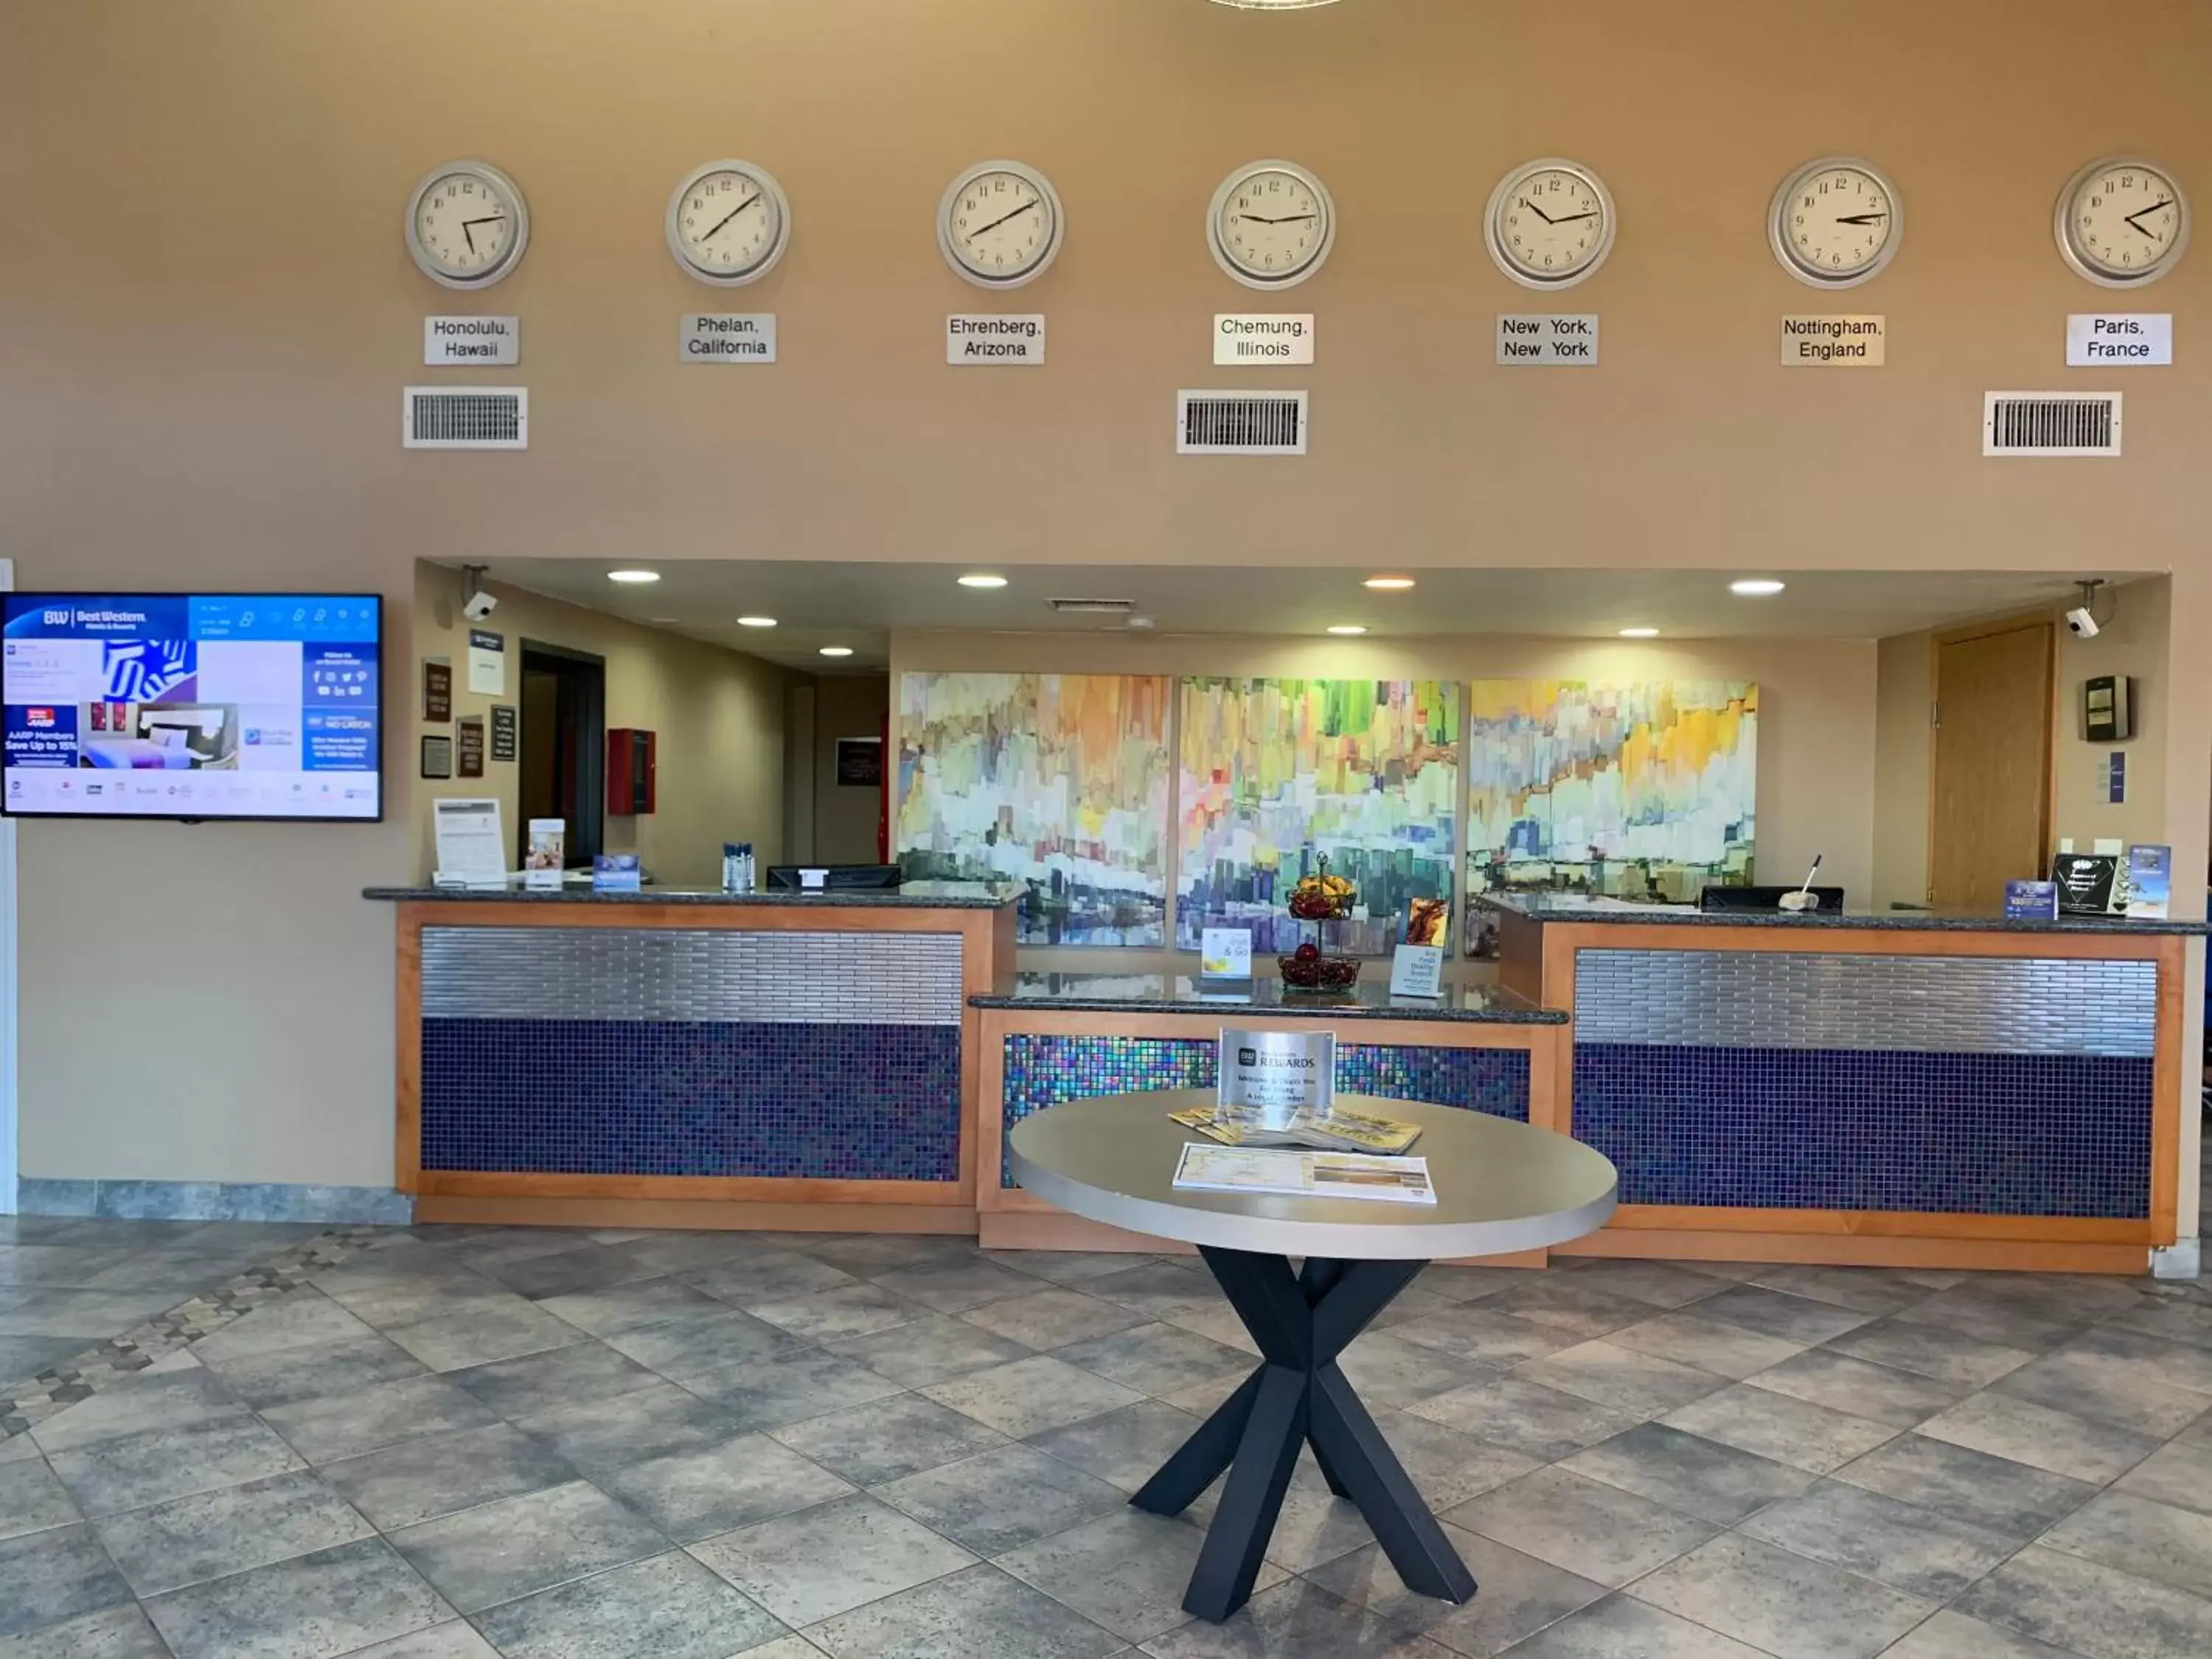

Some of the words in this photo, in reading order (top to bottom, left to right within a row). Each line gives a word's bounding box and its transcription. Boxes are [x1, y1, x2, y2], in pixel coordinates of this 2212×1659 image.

[721, 181, 731, 191] 12
[995, 181, 1004, 192] 12
[1269, 181, 1279, 192] 12
[1549, 180, 1560, 191] 12
[1836, 178, 1846, 189] 12
[2106, 181, 2114, 193] 11
[2122, 176, 2132, 187] 12
[2144, 179, 2147, 191] 1
[448, 186, 456, 197] 11
[463, 183, 473, 193] 12
[706, 184, 714, 196] 11
[742, 184, 745, 194] 1
[980, 186, 987, 197] 11
[1016, 184, 1019, 195] 1
[1253, 184, 1262, 195] 11
[1290, 186, 1293, 196] 1
[1534, 184, 1542, 195] 11
[1571, 184, 1574, 196] 1
[1819, 183, 1827, 194] 11
[1857, 183, 1861, 194] 1
[483, 189, 486, 199] 1
[434, 198, 444, 208] 10
[694, 199, 703, 209] 10
[967, 200, 975, 210] 10
[1239, 198, 1248, 209] 10
[1301, 200, 1308, 210] 2
[1519, 198, 1528, 208] 10
[1582, 200, 1589, 210] 2
[1805, 197, 1815, 207] 10
[1869, 197, 1877, 207] 2
[2093, 196, 2101, 207] 10
[427, 216, 433, 225] 9
[687, 217, 694, 227] 9
[960, 218, 967, 227] 9
[1231, 216, 1237, 225] 9
[1510, 216, 1517, 226] 9
[1796, 215, 1804, 226] 9
[2084, 216, 2091, 226] 9
[2163, 213, 2170, 224] 3
[1586, 220, 1593, 230] 3
[1236, 234, 1241, 244] 8
[1298, 237, 1303, 248] 4
[1514, 235, 1520, 246] 8
[1577, 239, 1584, 248] 4
[1801, 235, 1807, 245] 8
[1866, 235, 1872, 246] 4
[2090, 235, 2096, 245] 8
[443, 248, 449, 259] 7
[706, 248, 713, 258] 7
[723, 251, 730, 262] 6
[743, 246, 749, 257] 5
[979, 249, 984, 260] 7
[1016, 249, 1022, 260] 5
[1248, 248, 1254, 258] 7
[1286, 250, 1292, 261] 5
[1528, 249, 1534, 260] 7
[1566, 251, 1573, 261] 5
[1816, 248, 1821, 259] 7
[1854, 248, 1861, 259] 5
[2105, 248, 2111, 258] 7
[2124, 251, 2129, 263] 6
[2145, 246, 2151, 257] 5
[459, 255, 465, 266] 6
[996, 254, 1003, 264] 6
[1265, 254, 1272, 264] 6
[1545, 254, 1552, 265] 6
[1833, 254, 1840, 264] 6
[434, 321, 509, 336] Honolulu,
[697, 318, 759, 333] Phelan,
[950, 319, 1042, 337] Ehrenberg,
[1221, 319, 1307, 337] Chemung,
[1502, 319, 1541, 335] New
[1550, 319, 1593, 335] York,
[1784, 319, 1882, 339] Nottingham,
[2094, 319, 2145, 335] Paris,
[445, 341, 498, 357] Hawaii
[688, 338, 768, 355] California
[964, 341, 1027, 357] Arizona
[1237, 341, 1290, 357] Illinois
[1503, 341, 1543, 357] New
[1551, 341, 1589, 357] York
[1799, 341, 1866, 361] England
[2087, 341, 2150, 358] France
[44, 611, 69, 625] BW
[77, 611, 100, 622] Best
[8, 731, 34, 740] AARP
[5, 741, 29, 750] Save
[30, 741, 44, 751] Up
[46, 741, 58, 750] to
[1260, 1057, 1315, 1068] REWARDS
